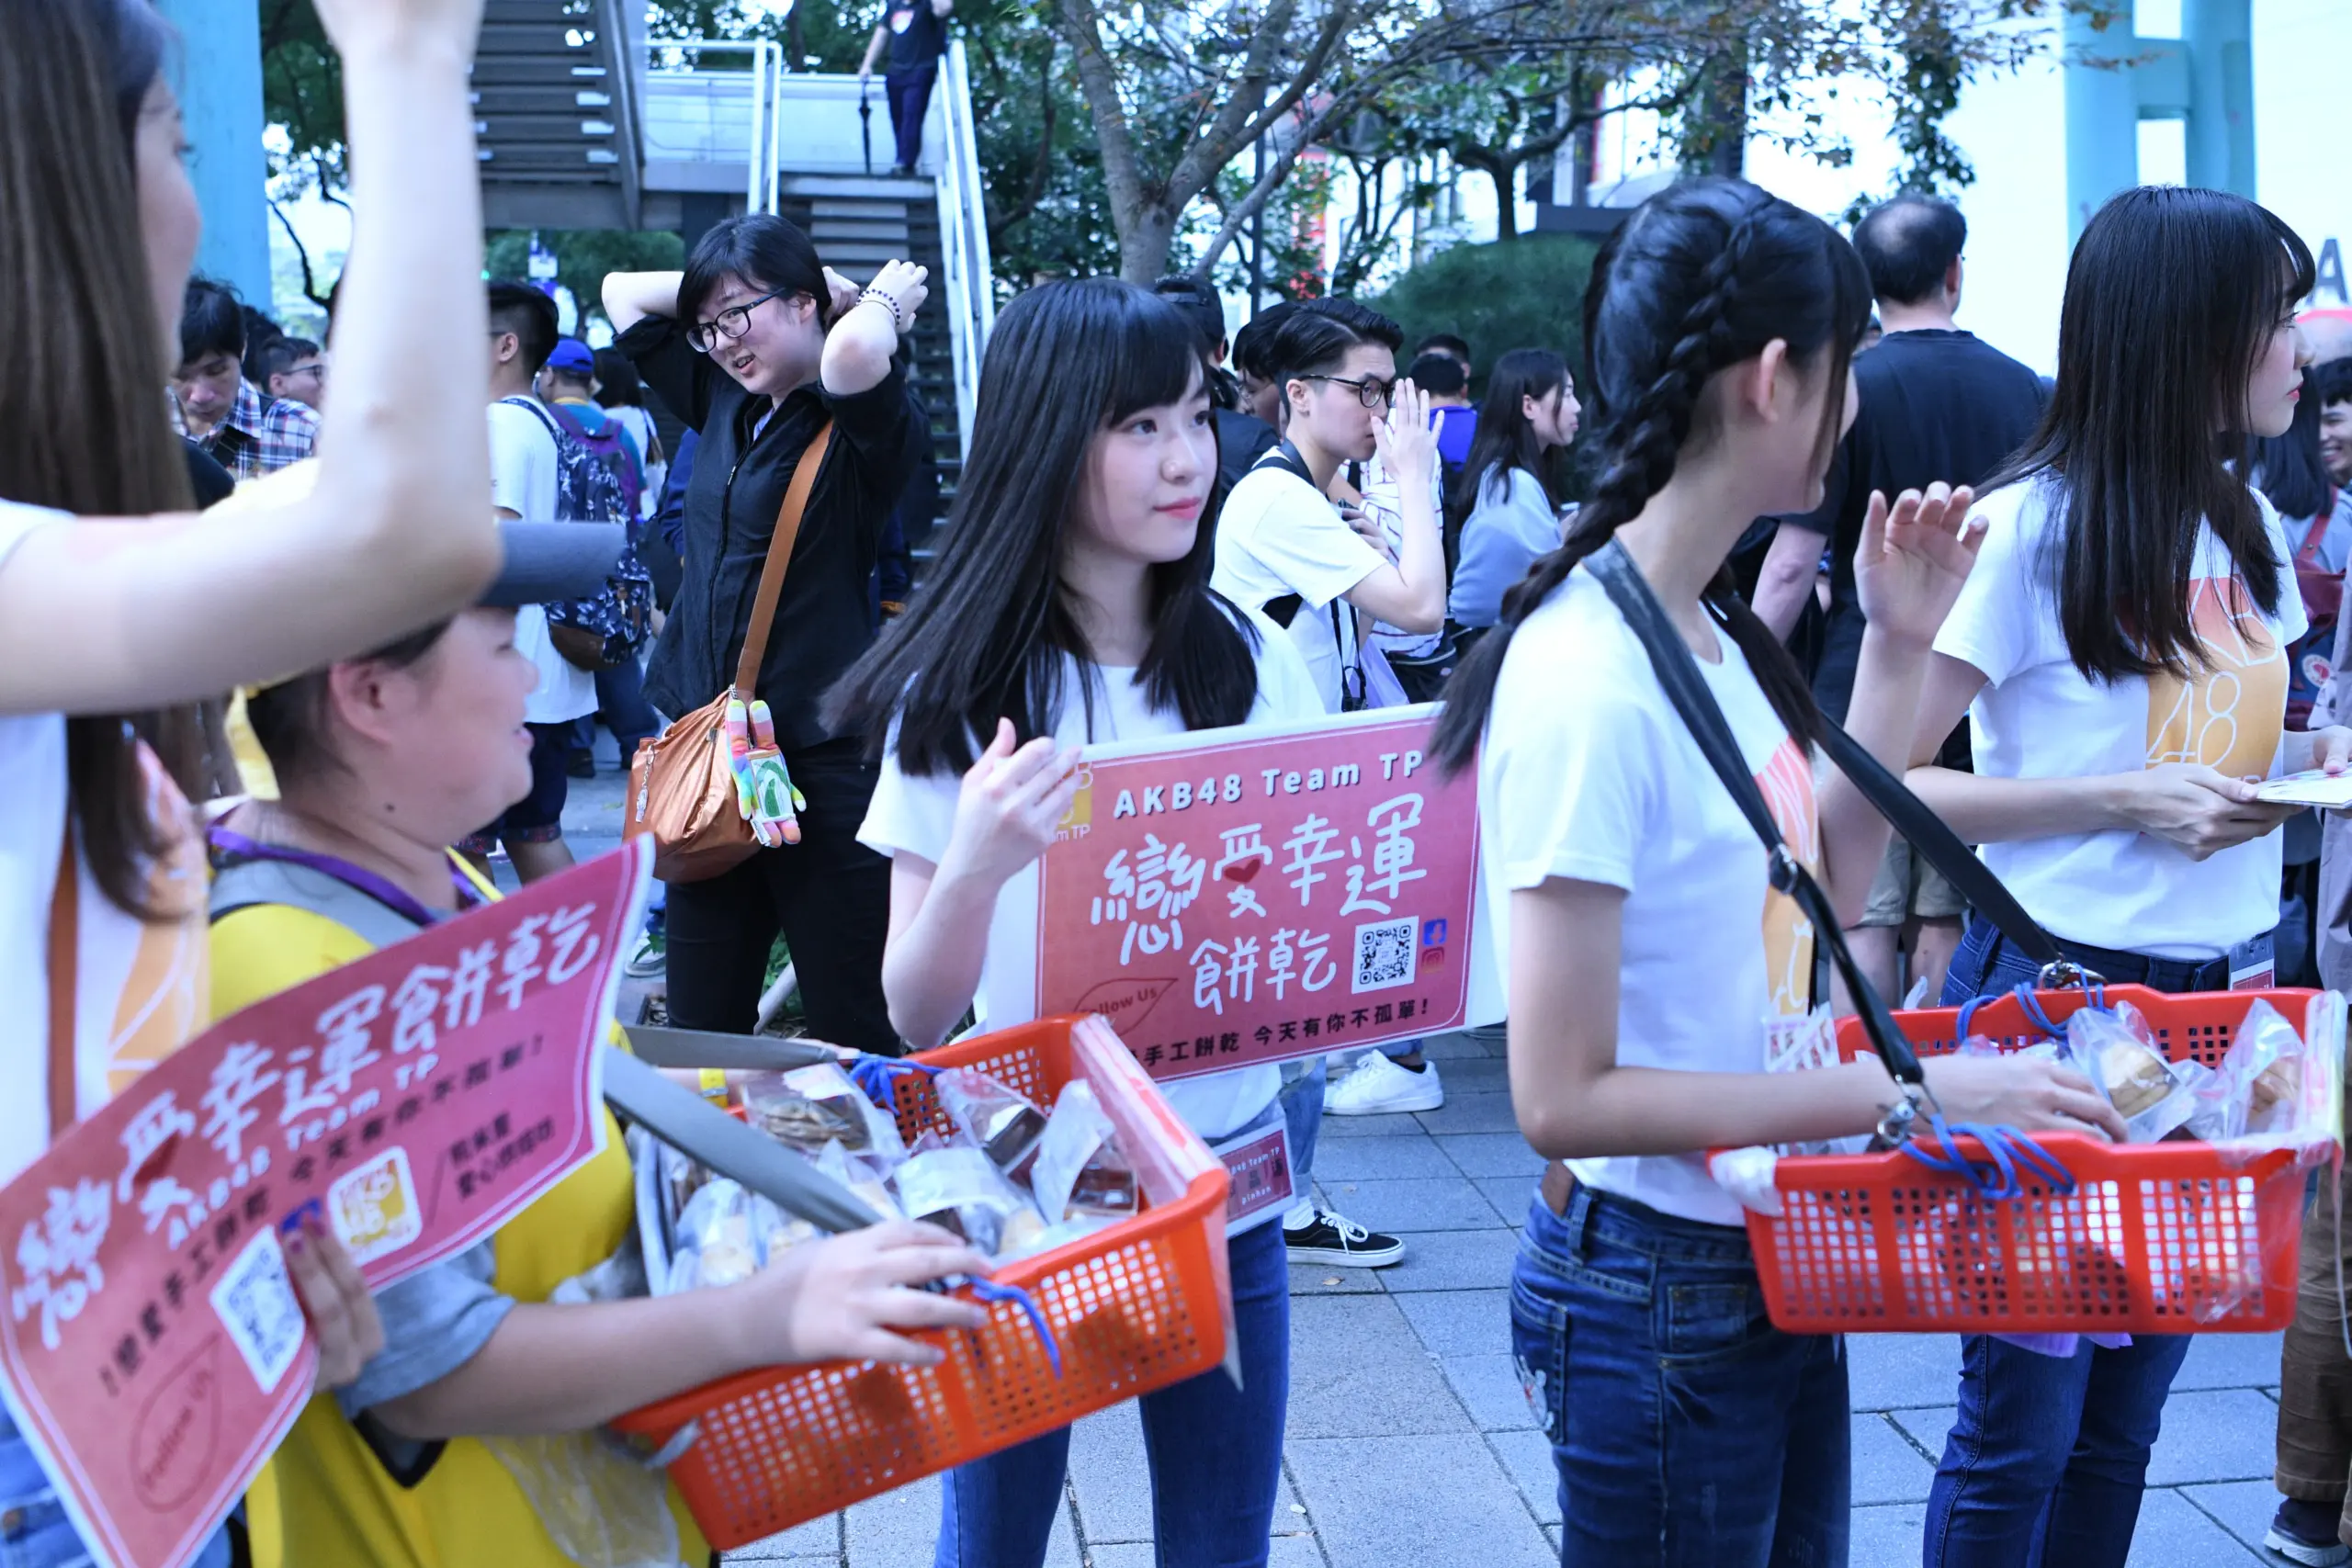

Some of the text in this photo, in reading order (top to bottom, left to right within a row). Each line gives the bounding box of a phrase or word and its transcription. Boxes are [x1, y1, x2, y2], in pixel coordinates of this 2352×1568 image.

[2145, 671, 2242, 770] 48
[1113, 772, 1243, 820] AKB48
[1261, 762, 1362, 797] Team
[1378, 749, 1423, 781] TP
[1137, 987, 1159, 1006] Us
[1189, 927, 1338, 1016] 餅乾
[395, 1053, 441, 1091] TP
